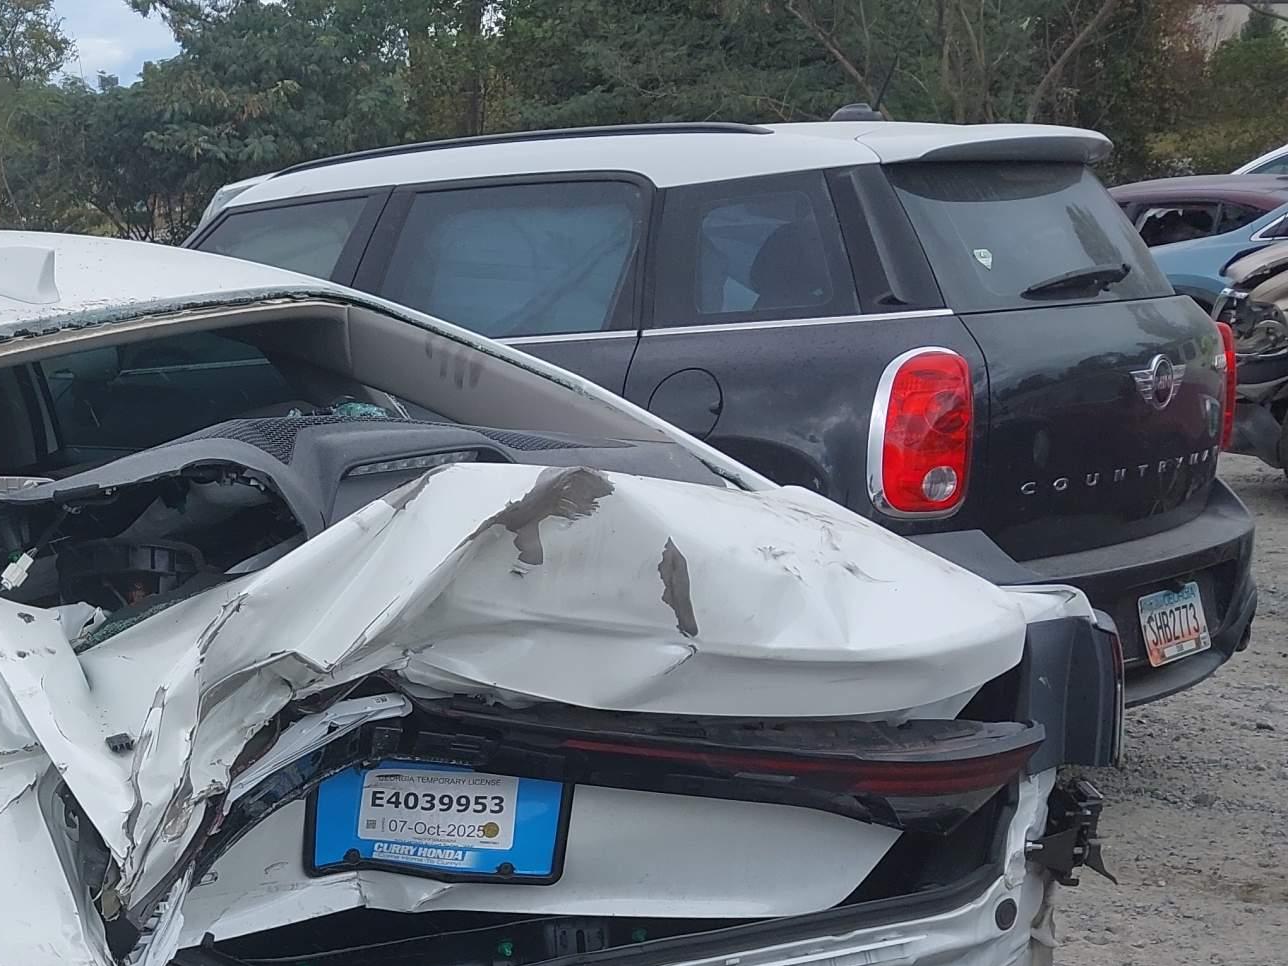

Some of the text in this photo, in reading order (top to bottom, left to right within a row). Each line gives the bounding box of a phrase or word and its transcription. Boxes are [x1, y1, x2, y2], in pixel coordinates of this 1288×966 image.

[1147, 602, 1200, 647] SHB2773
[378, 774, 502, 786] GEORGIA TEMPORARY LICENSE
[371, 790, 504, 814] E4039953
[388, 819, 486, 838] 07-Oct-2025
[374, 842, 417, 856] CURRY
[417, 846, 463, 861] HONDA
